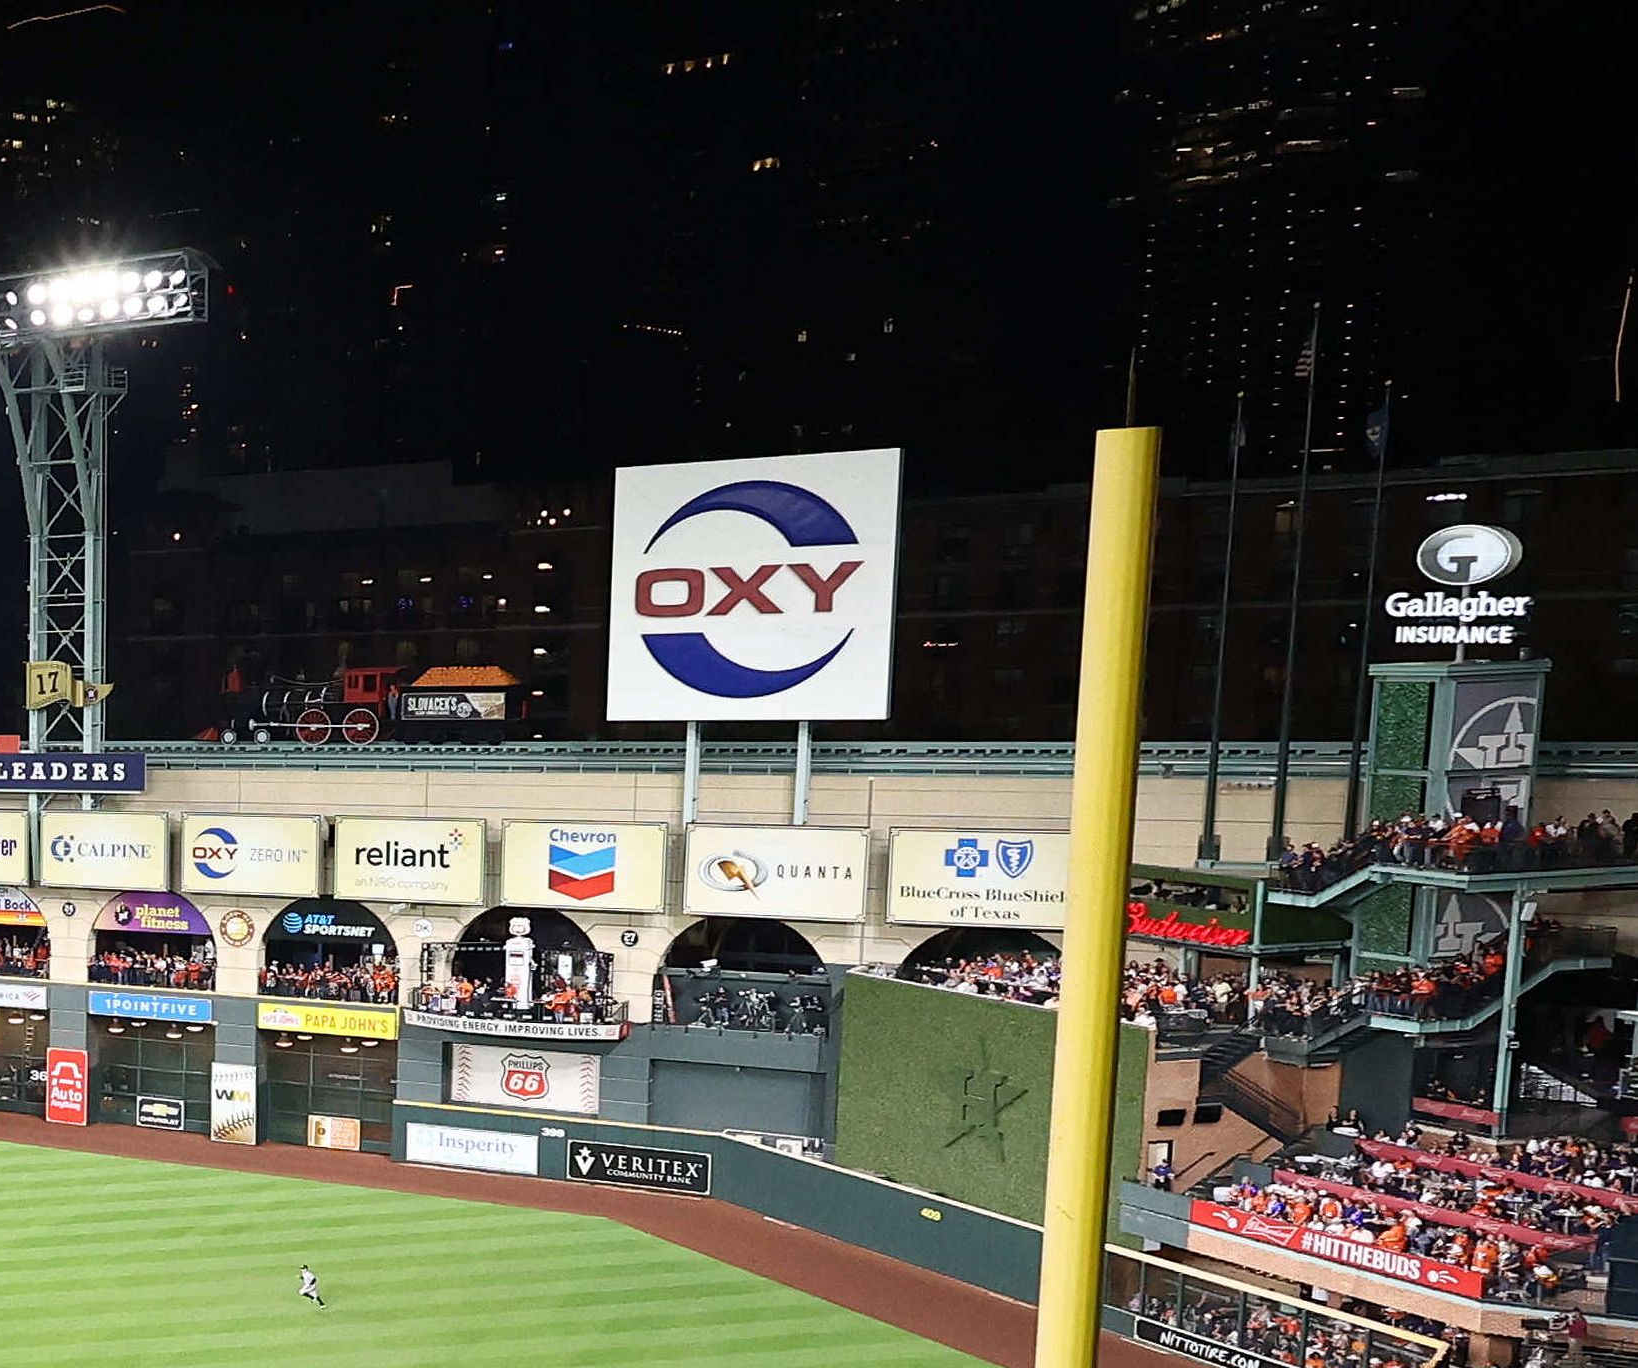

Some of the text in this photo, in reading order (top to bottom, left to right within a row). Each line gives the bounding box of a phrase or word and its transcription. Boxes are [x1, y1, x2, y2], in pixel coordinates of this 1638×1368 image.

[634, 560, 863, 619] OXY
[1385, 591, 1531, 621] Gallagher
[1395, 626, 1513, 644] INSURANCE
[36, 671, 60, 695] 17
[407, 696, 458, 711] SLOVACEK'S
[549, 829, 617, 845] Chevron
[77, 843, 152, 859] CALPINE
[192, 846, 283, 863] OXY ZERO
[355, 841, 451, 870] reliant
[776, 864, 854, 880] QUANTA
[398, 878, 450, 894] company
[899, 886, 1067, 904] BlueCross BlueShiel
[4, 897, 32, 911] Bock
[135, 904, 180, 920] planet
[950, 905, 1020, 920] of Texas
[140, 916, 189, 931] fitness
[305, 914, 335, 925] AT&T
[1126, 901, 1251, 946] Budweiser
[303, 924, 375, 937] SPORTSNET
[104, 998, 197, 1017] 1POINTFIVE
[305, 1014, 389, 1033] PAPA JOHN'S
[417, 1014, 460, 1030] PROVIDING
[504, 1023, 564, 1037] IMPROVING
[568, 1025, 601, 1037] LIVES.
[508, 1074, 541, 1092] 66
[51, 1086, 83, 1102] Auto
[438, 1132, 517, 1156] Insperity
[601, 1153, 700, 1178] VERITEX
[607, 1168, 692, 1185] COMMUNITY BANK
[1301, 1233, 1421, 1281] #HITTHEBUDS
